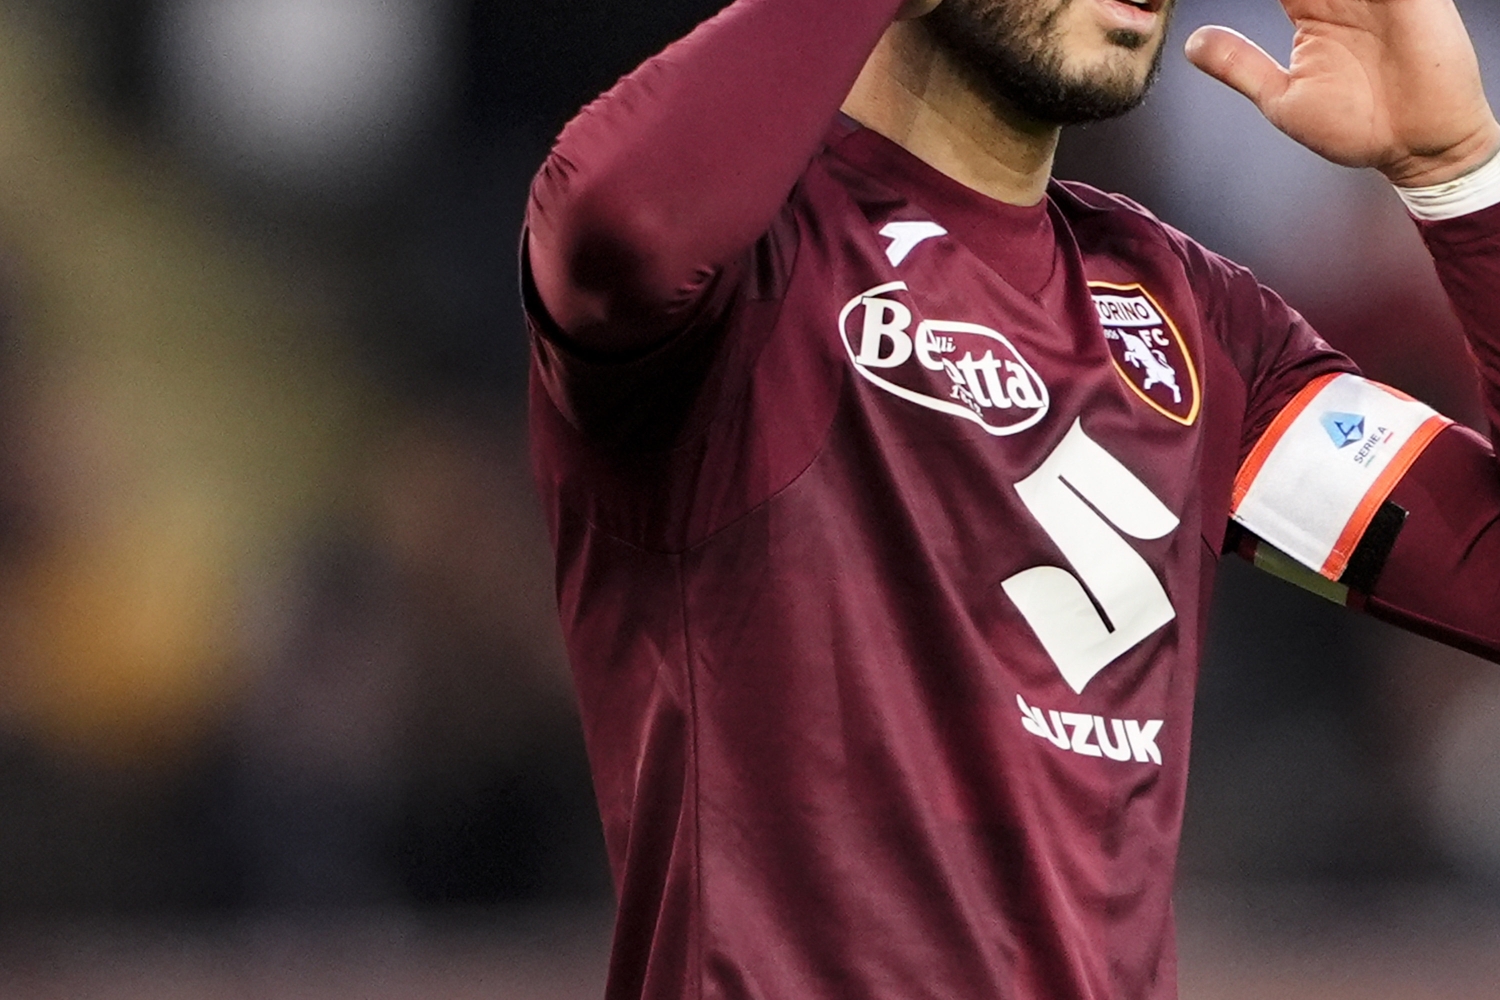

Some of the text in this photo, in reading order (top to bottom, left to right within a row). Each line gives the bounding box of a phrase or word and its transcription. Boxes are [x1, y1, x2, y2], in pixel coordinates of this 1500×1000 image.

[1093, 300, 1150, 321] ORINO
[1138, 328, 1170, 348] FC
[1353, 426, 1388, 464] SERIE A
[1016, 693, 1165, 766] SUZUK
